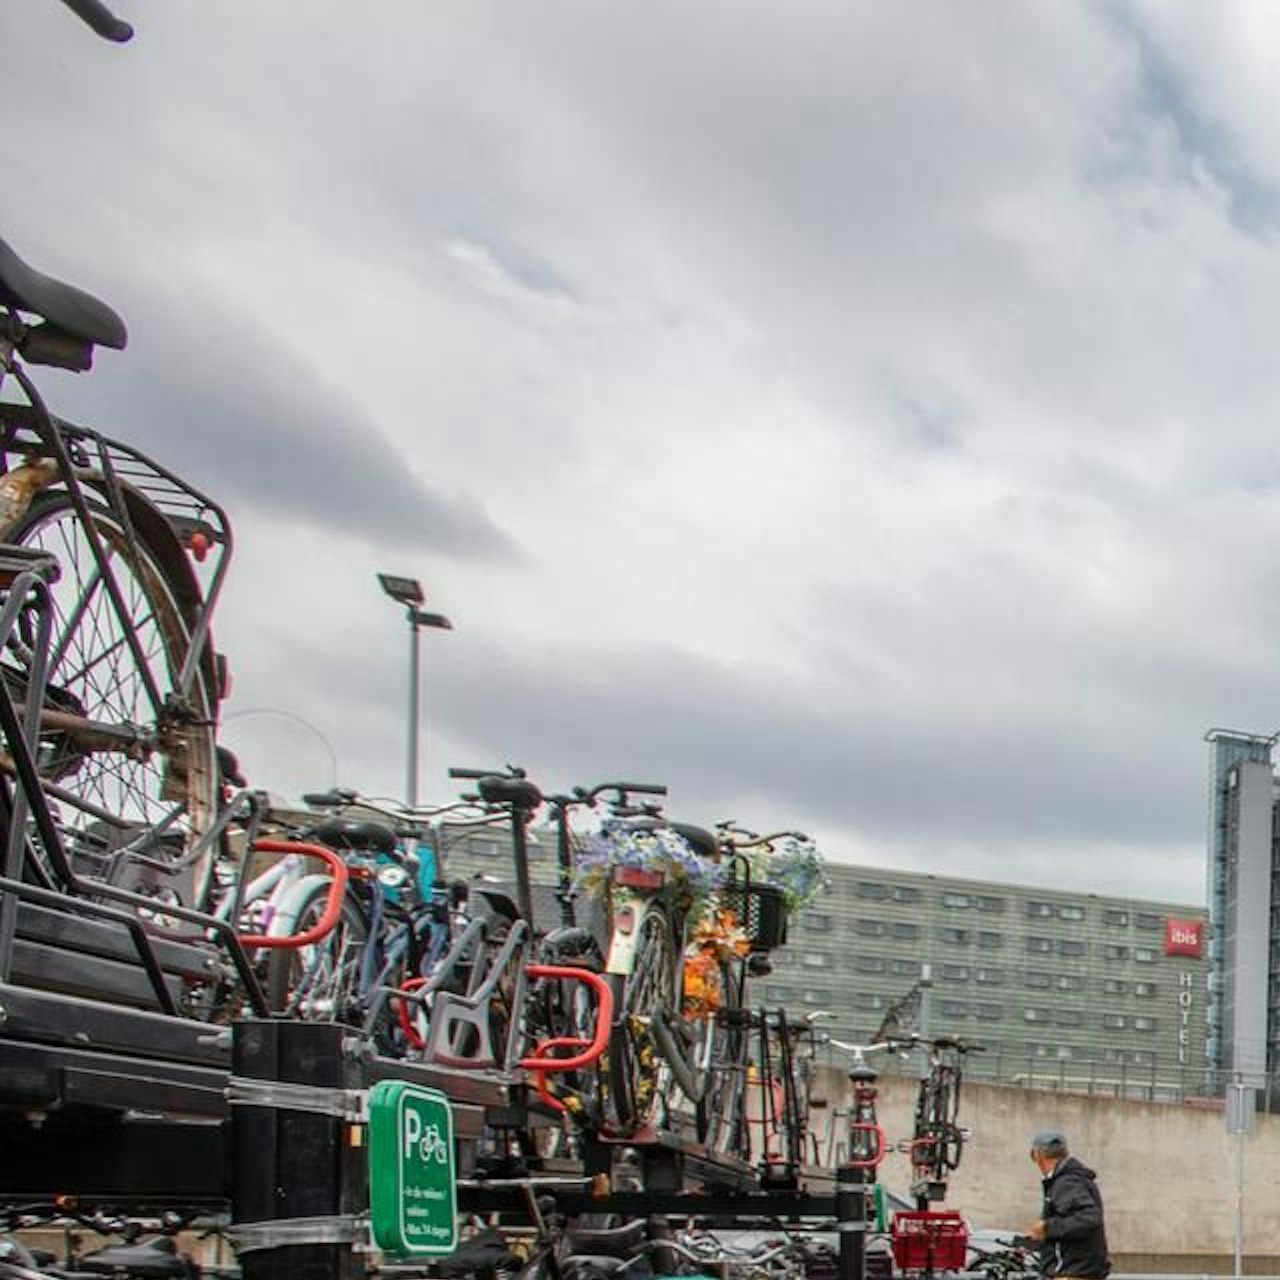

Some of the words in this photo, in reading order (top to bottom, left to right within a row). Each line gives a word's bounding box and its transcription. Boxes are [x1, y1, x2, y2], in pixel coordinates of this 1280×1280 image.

[1171, 927, 1197, 945] ibis
[1179, 972, 1192, 1063] HOTEL
[404, 1108, 421, 1159] P
